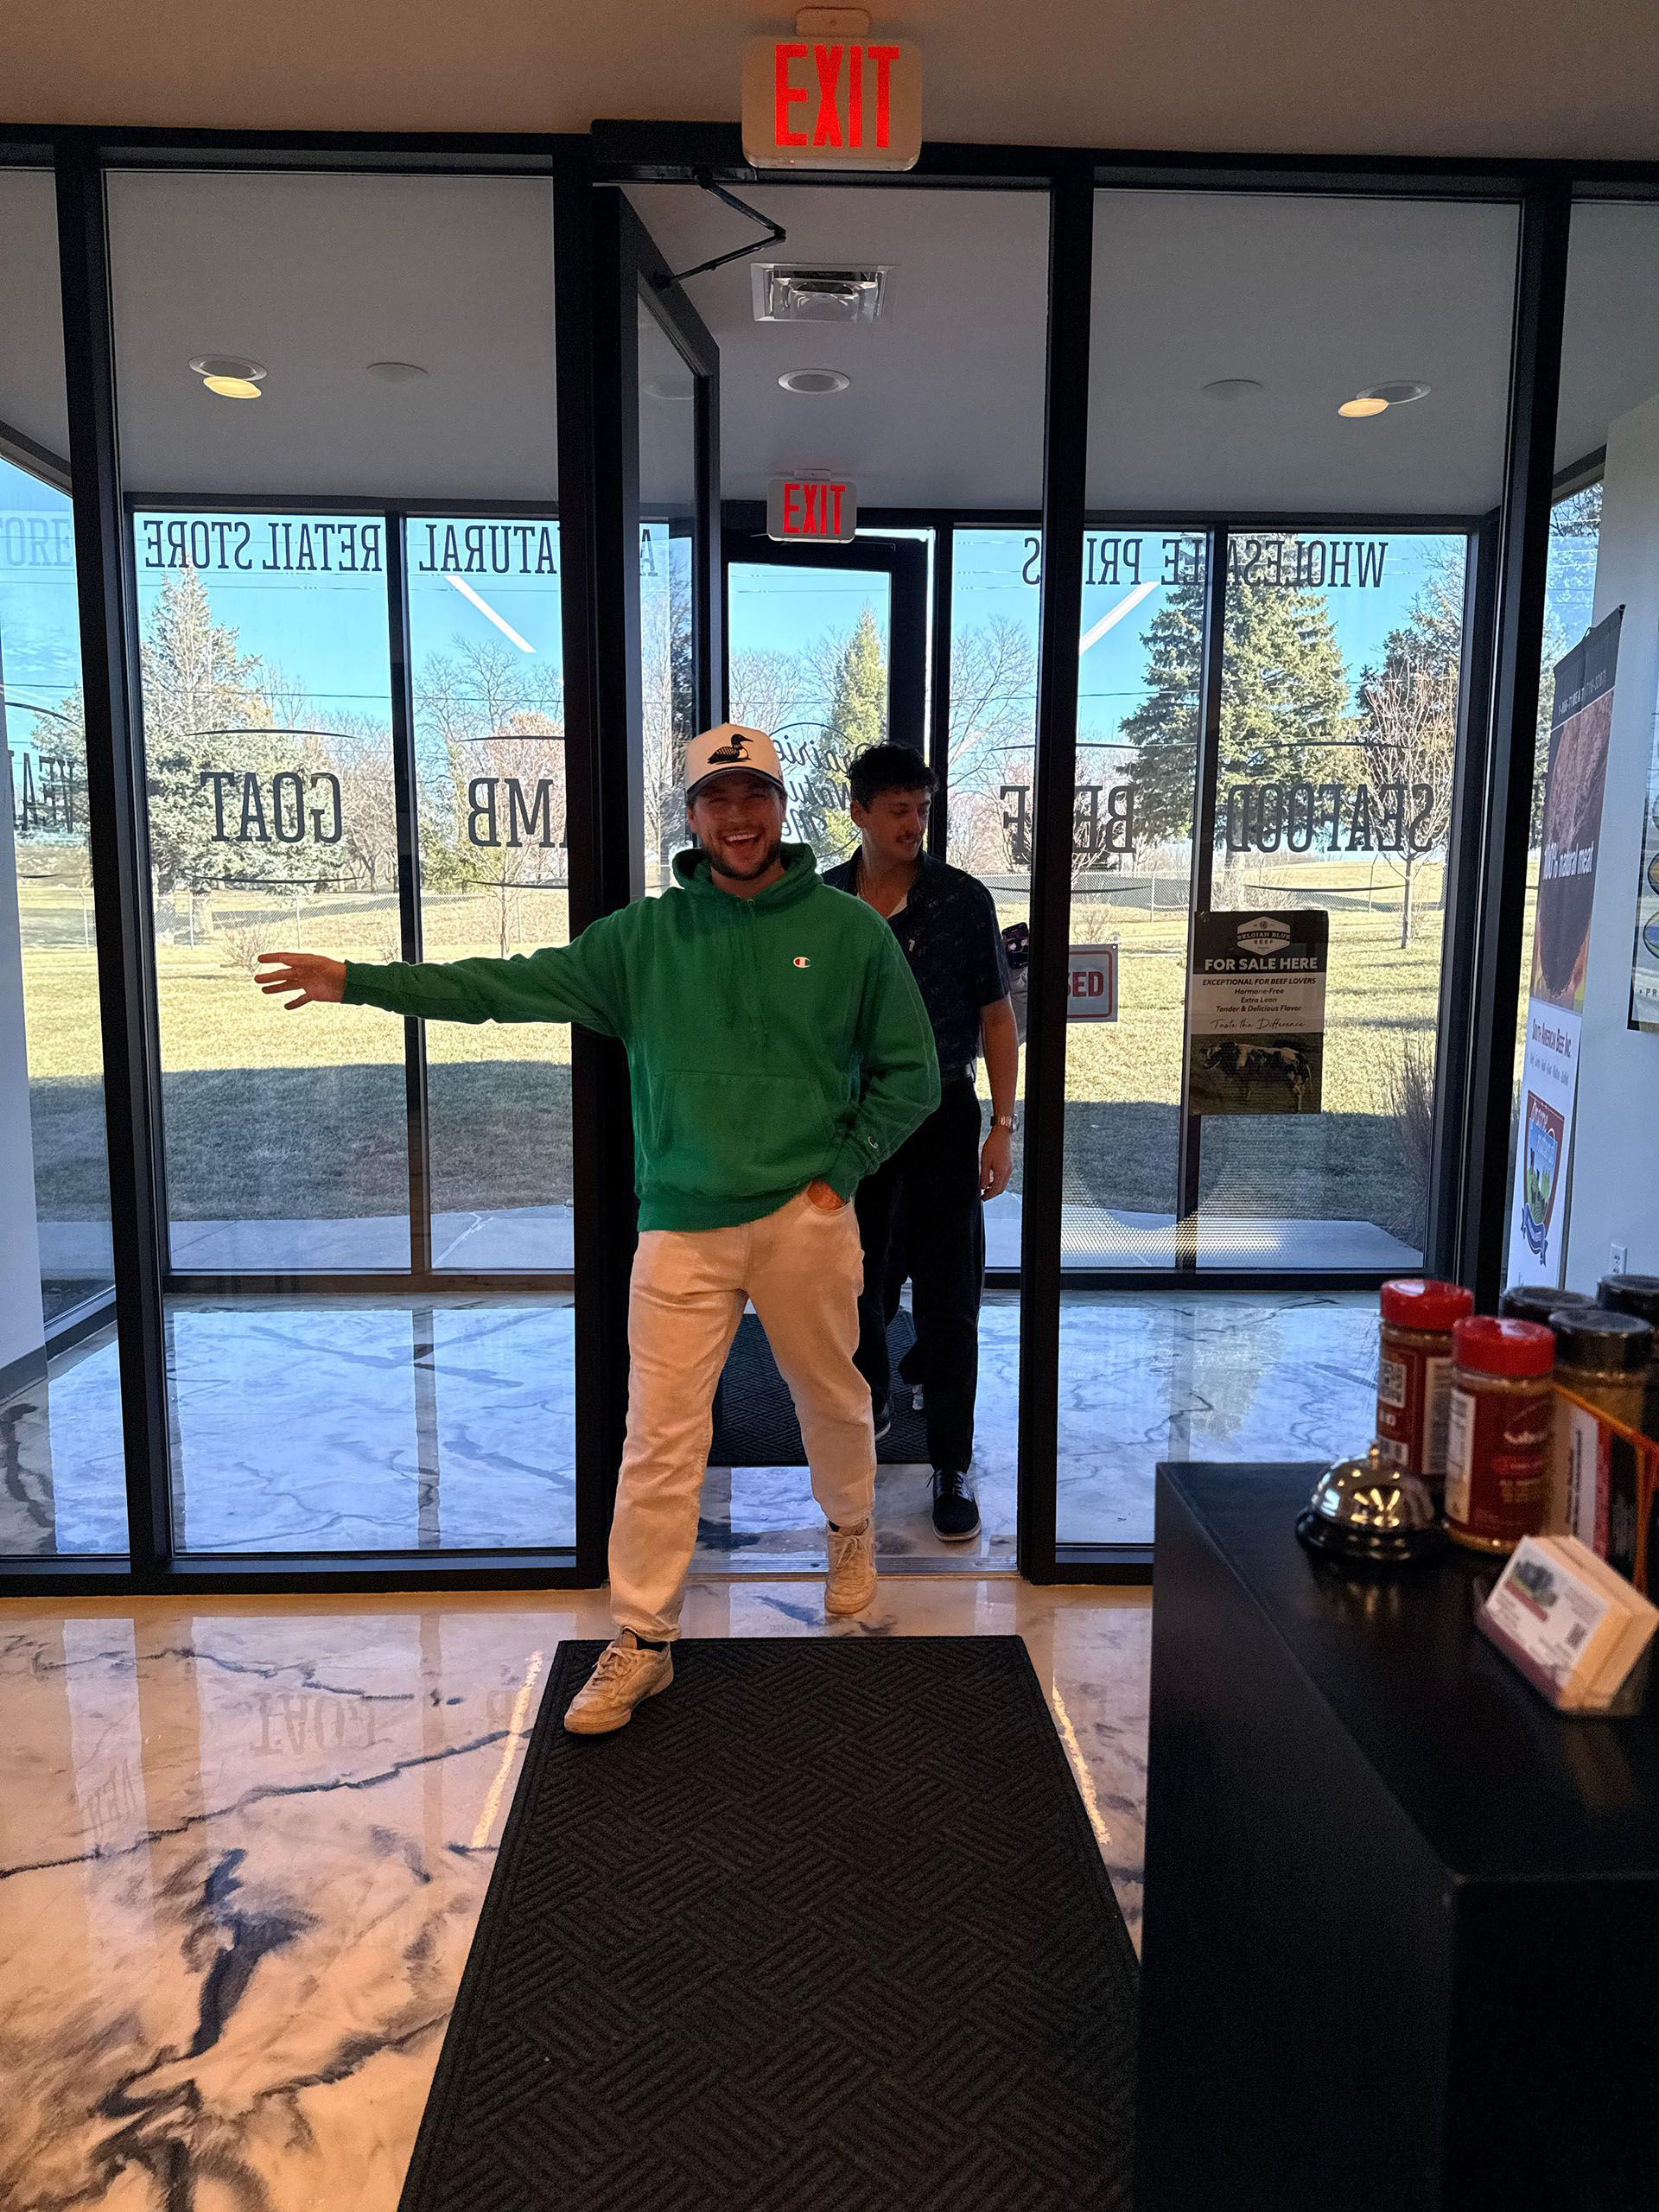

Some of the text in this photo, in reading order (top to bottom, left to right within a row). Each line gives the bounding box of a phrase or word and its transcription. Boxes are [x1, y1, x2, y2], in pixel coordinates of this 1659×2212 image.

[775, 43, 900, 149] EXIT
[783, 483, 847, 535] EXIT
[1205, 957, 1318, 970] FOR SALE HERE
[1210, 1018, 1306, 1029] Taste the Difference
